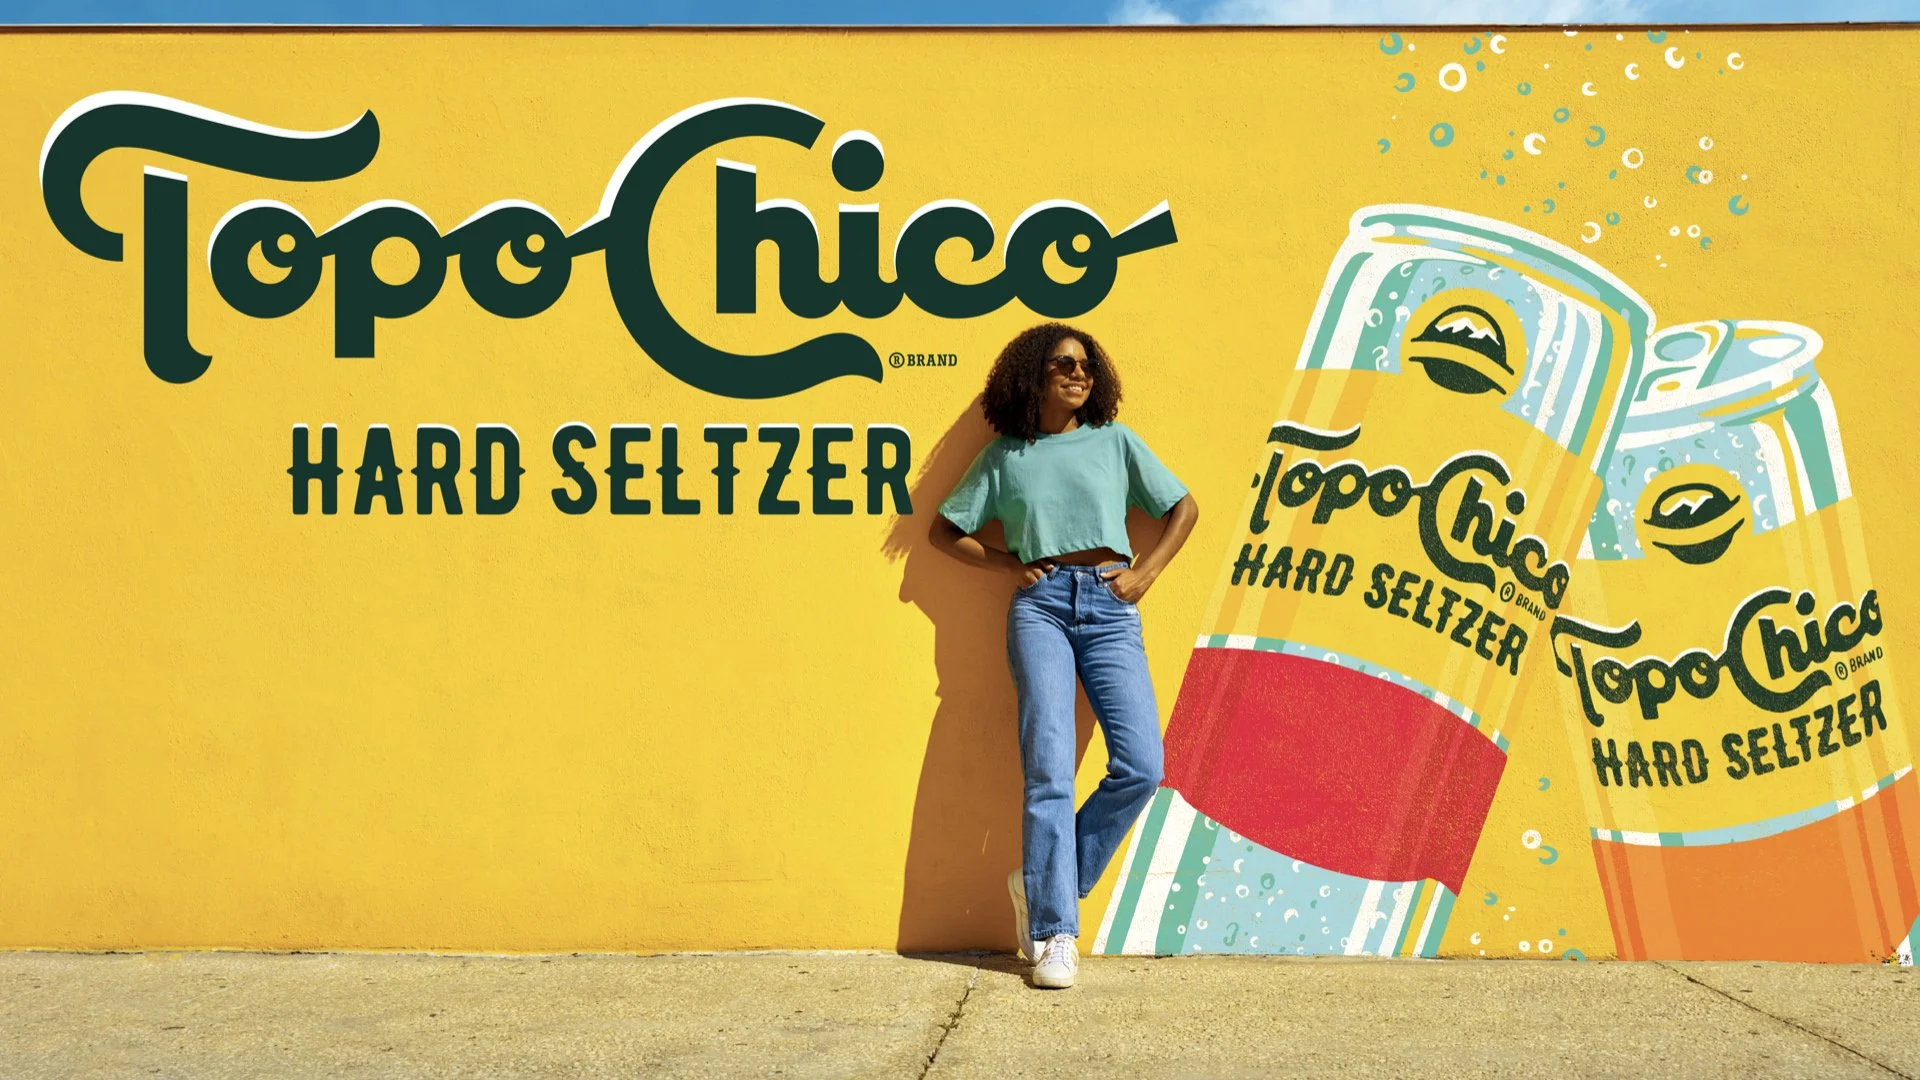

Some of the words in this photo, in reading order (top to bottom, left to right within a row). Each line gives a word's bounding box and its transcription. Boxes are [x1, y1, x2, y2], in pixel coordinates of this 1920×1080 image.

[39, 90, 608, 384] Topo
[598, 97, 1178, 399] Chico
[907, 353, 957, 367] BRAND
[287, 423, 525, 515] HARD
[551, 421, 913, 515] SELTZER
[1231, 543, 1354, 596] HARD
[1363, 562, 1528, 676] SELTZER
[1515, 592, 1546, 622] BRAND
[1849, 646, 1883, 673] BRAND
[1592, 737, 1709, 788] HARD
[1721, 679, 1886, 780] SELTZER
